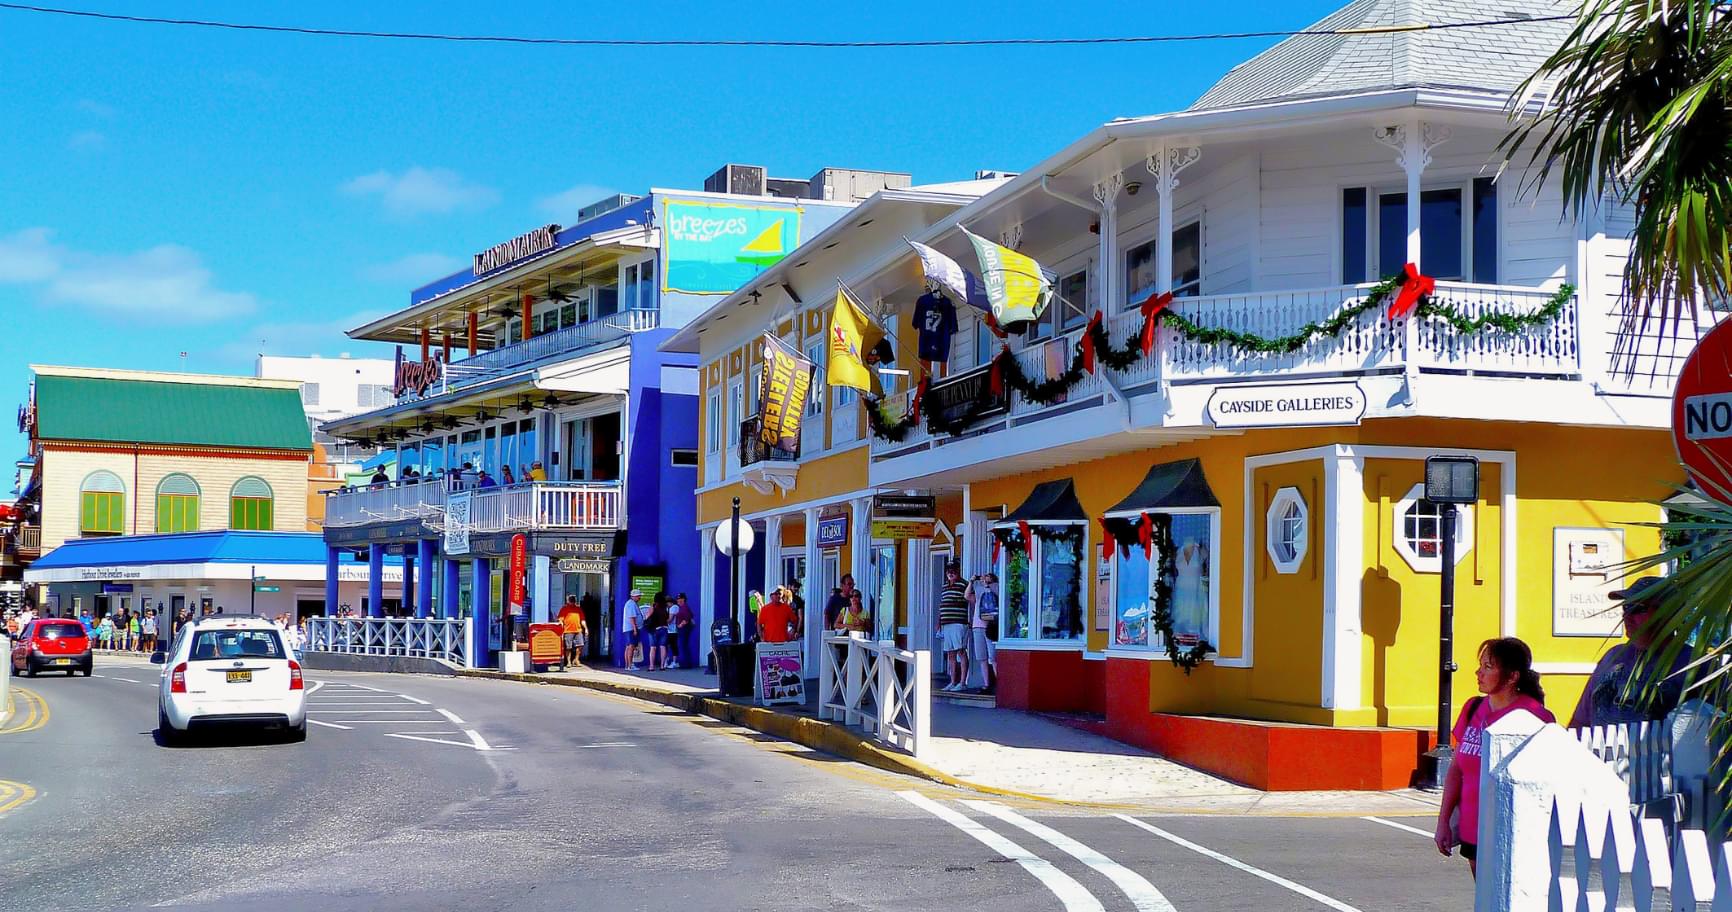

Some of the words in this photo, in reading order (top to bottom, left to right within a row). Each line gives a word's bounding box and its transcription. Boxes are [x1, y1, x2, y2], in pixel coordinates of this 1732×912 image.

[669, 211, 748, 238] breezes
[473, 224, 554, 276] LANDMARK
[1220, 399, 1273, 413] CAYSIDE
[1277, 396, 1353, 412] GALLERIES
[1686, 401, 1732, 434] NO
[554, 543, 579, 551] DUTY
[582, 543, 607, 552] FREE
[564, 560, 609, 571] LANDMARK
[1569, 593, 1609, 604] ISLAND
